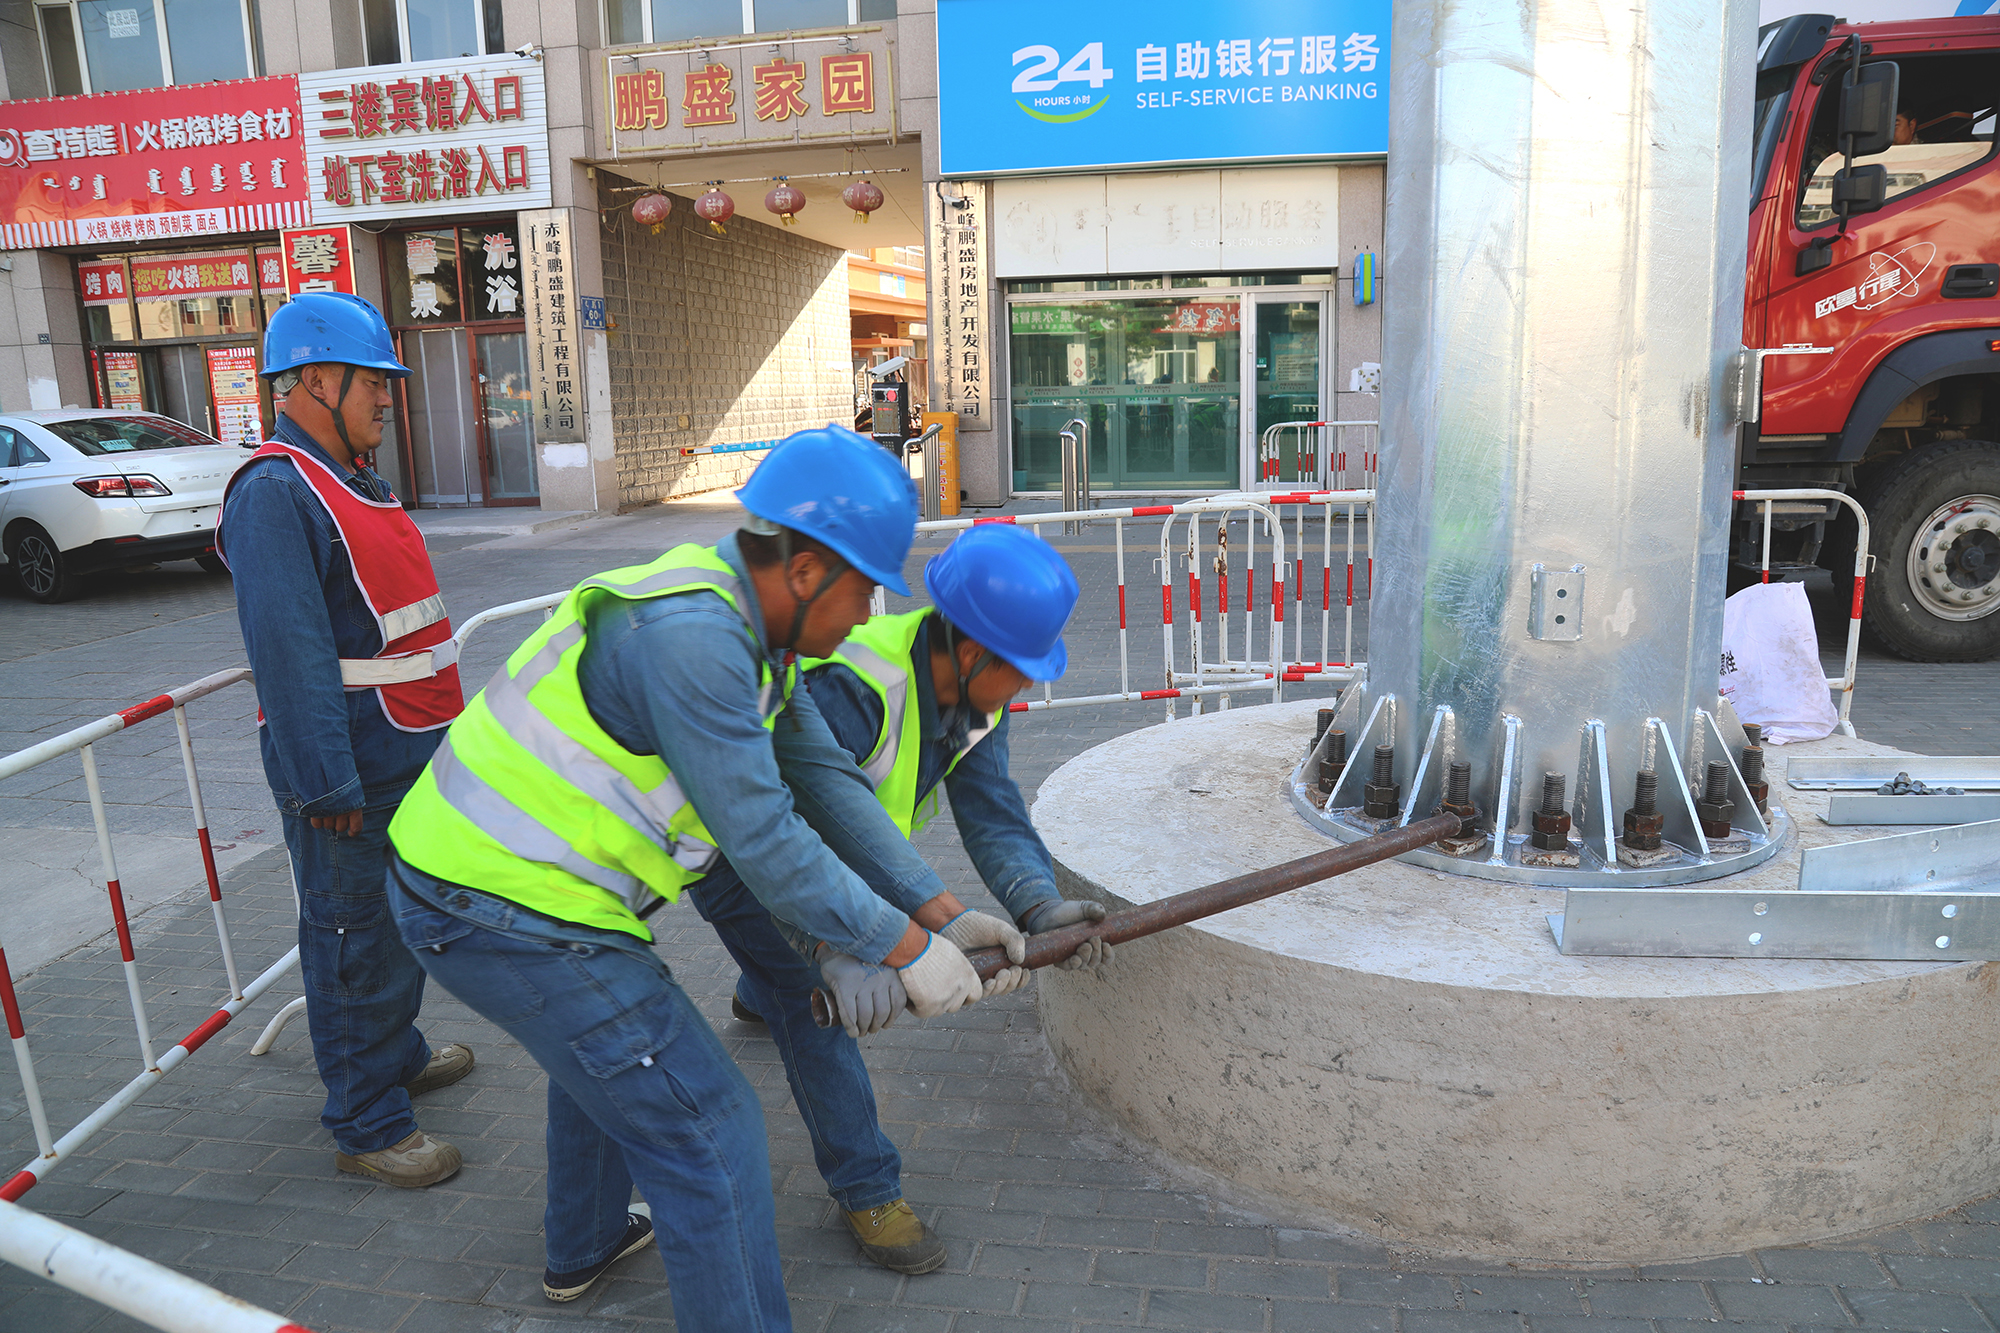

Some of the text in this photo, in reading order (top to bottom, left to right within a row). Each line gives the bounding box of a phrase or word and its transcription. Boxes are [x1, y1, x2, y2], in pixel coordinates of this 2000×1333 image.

[1011, 42, 1113, 93] 24
[1136, 32, 1380, 83] 自助银行服务
[318, 73, 525, 140] 三楼宾馆入口
[614, 52, 875, 130] 鹏盛家园
[1034, 94, 1091, 107] HOURS 小时
[1136, 82, 1378, 109] SELF-SERVICE BANKING
[134, 107, 293, 152] 火锅烧烤食材
[322, 144, 530, 207] 地下室洗浴入口
[86, 212, 219, 240] 火锅 烧烤 烤肉 预制菜 面点
[85, 270, 124, 296] 烤肉
[135, 261, 249, 292] 您吃火锅我送肉
[262, 258, 281, 284] 烧
[406, 238, 442, 319] 馨泉
[482, 232, 519, 314] 洗浴
[1815, 268, 1901, 319] 欧曼行星
[544, 222, 574, 430] 赤峰鹏盛建筑工程有限公司
